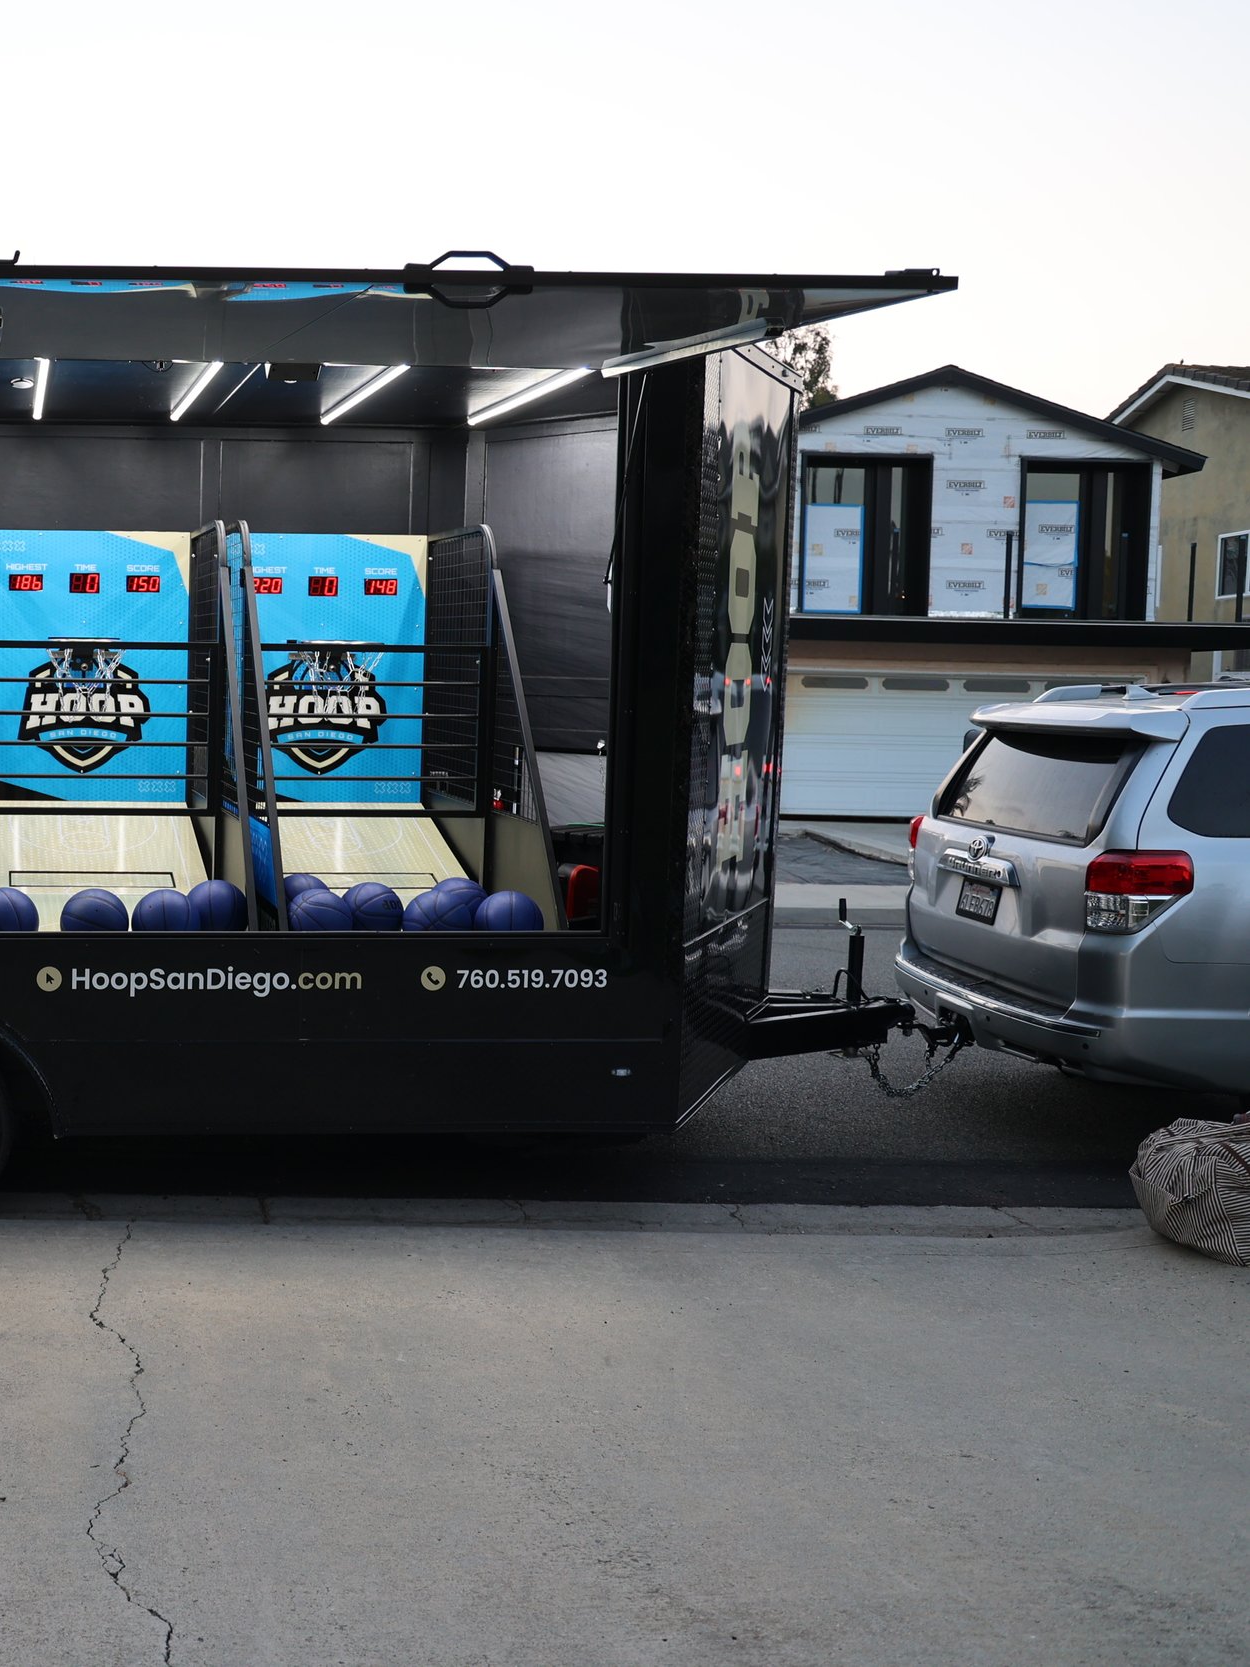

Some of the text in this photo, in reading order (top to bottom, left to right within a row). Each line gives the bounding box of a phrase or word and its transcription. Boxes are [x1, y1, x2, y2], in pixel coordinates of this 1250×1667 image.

[6, 563, 160, 572] HIGHEST TIME SCORE
[253, 566, 398, 575] IGHEST TIME SCORE
[86, 574, 98, 593] 0
[133, 576, 159, 591] 150
[324, 577, 336, 595] 0
[370, 579, 396, 594] 148
[717, 424, 760, 872] HOOP
[26, 693, 145, 730] HOOP
[268, 695, 381, 730] HOOP
[50, 727, 117, 739] SAN DIEGO
[287, 731, 354, 740] SAN DIEGO
[71, 966, 362, 997] HoopSanDiego.com
[457, 968, 608, 990] 760.519.7093
